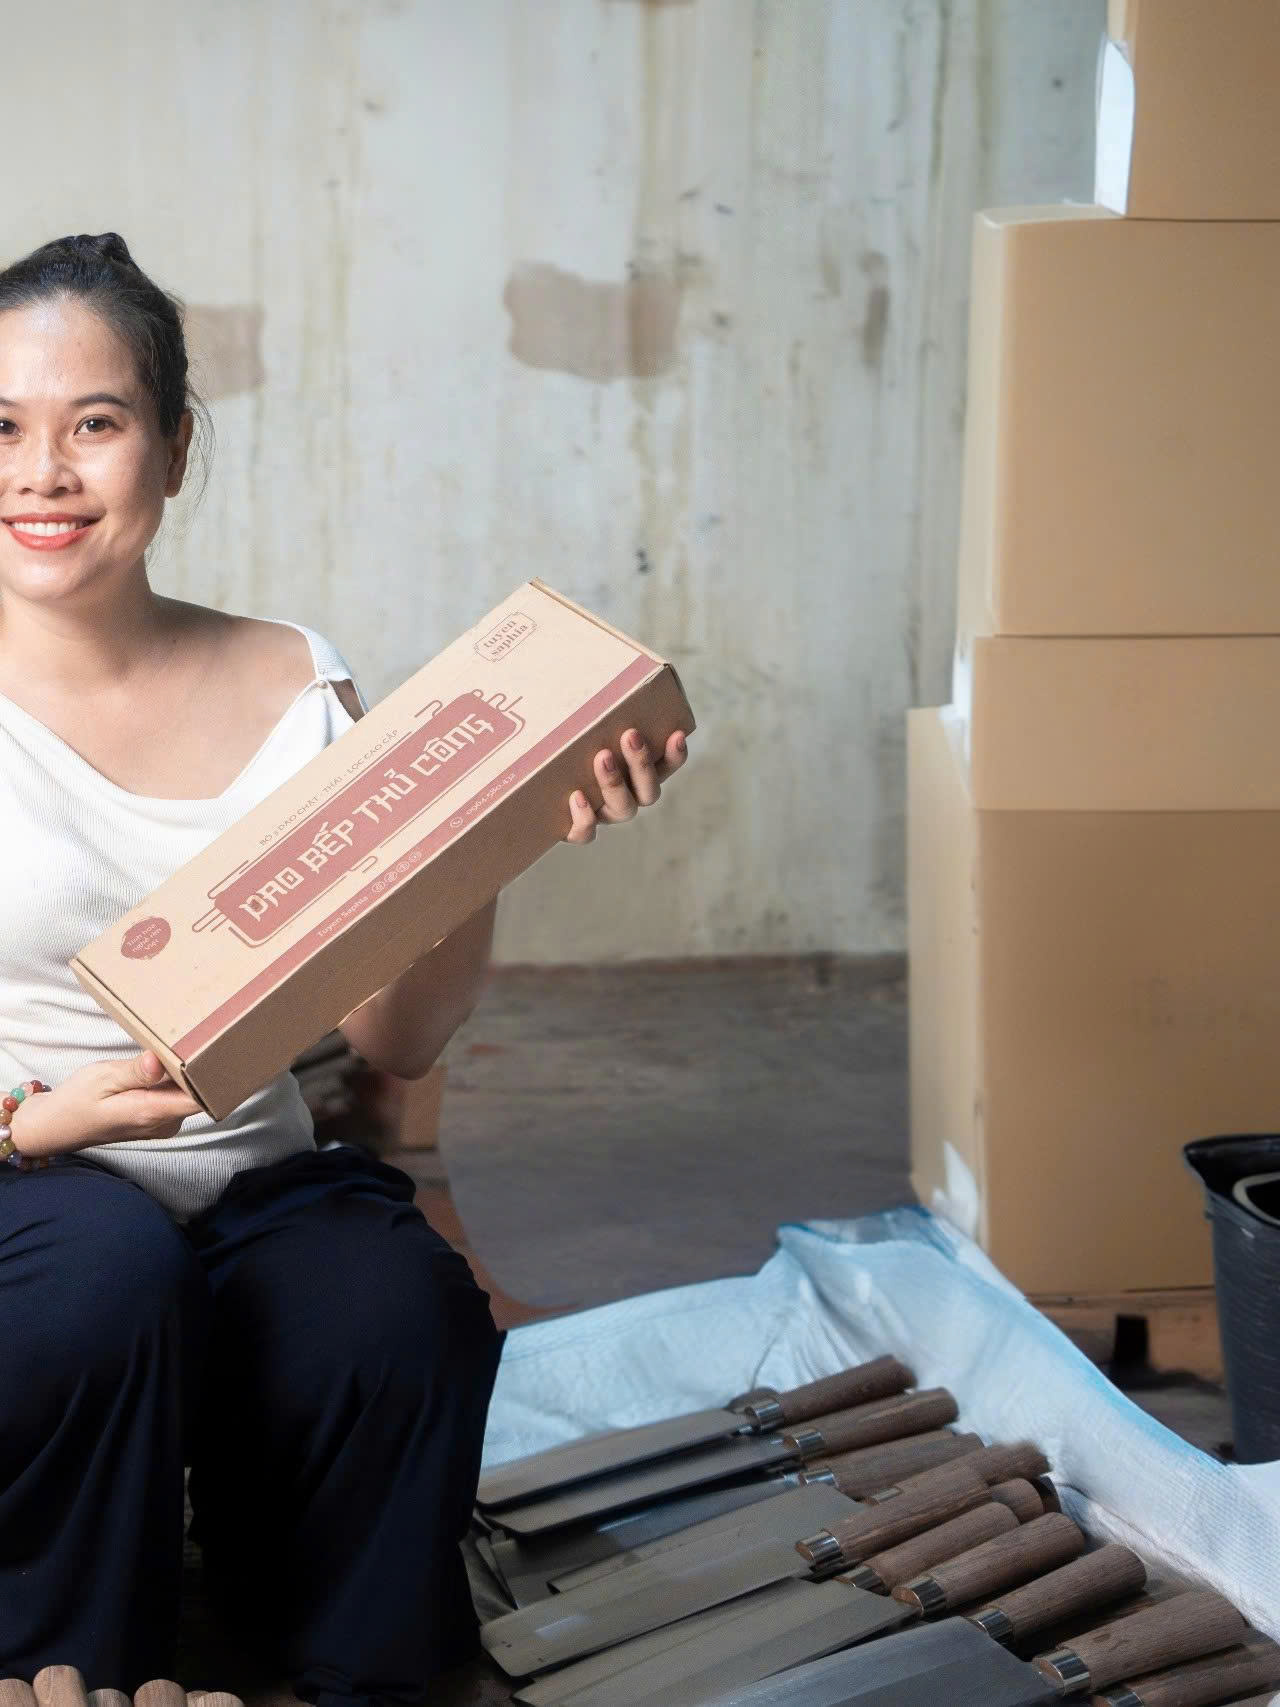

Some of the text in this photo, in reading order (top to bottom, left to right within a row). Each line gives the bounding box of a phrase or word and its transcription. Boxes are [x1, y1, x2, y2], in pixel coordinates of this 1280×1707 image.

[238, 713, 495, 922] DAO BẾP THỦ CÔNG
[278, 814, 297, 831] DAO
[364, 743, 383, 760] CAO
